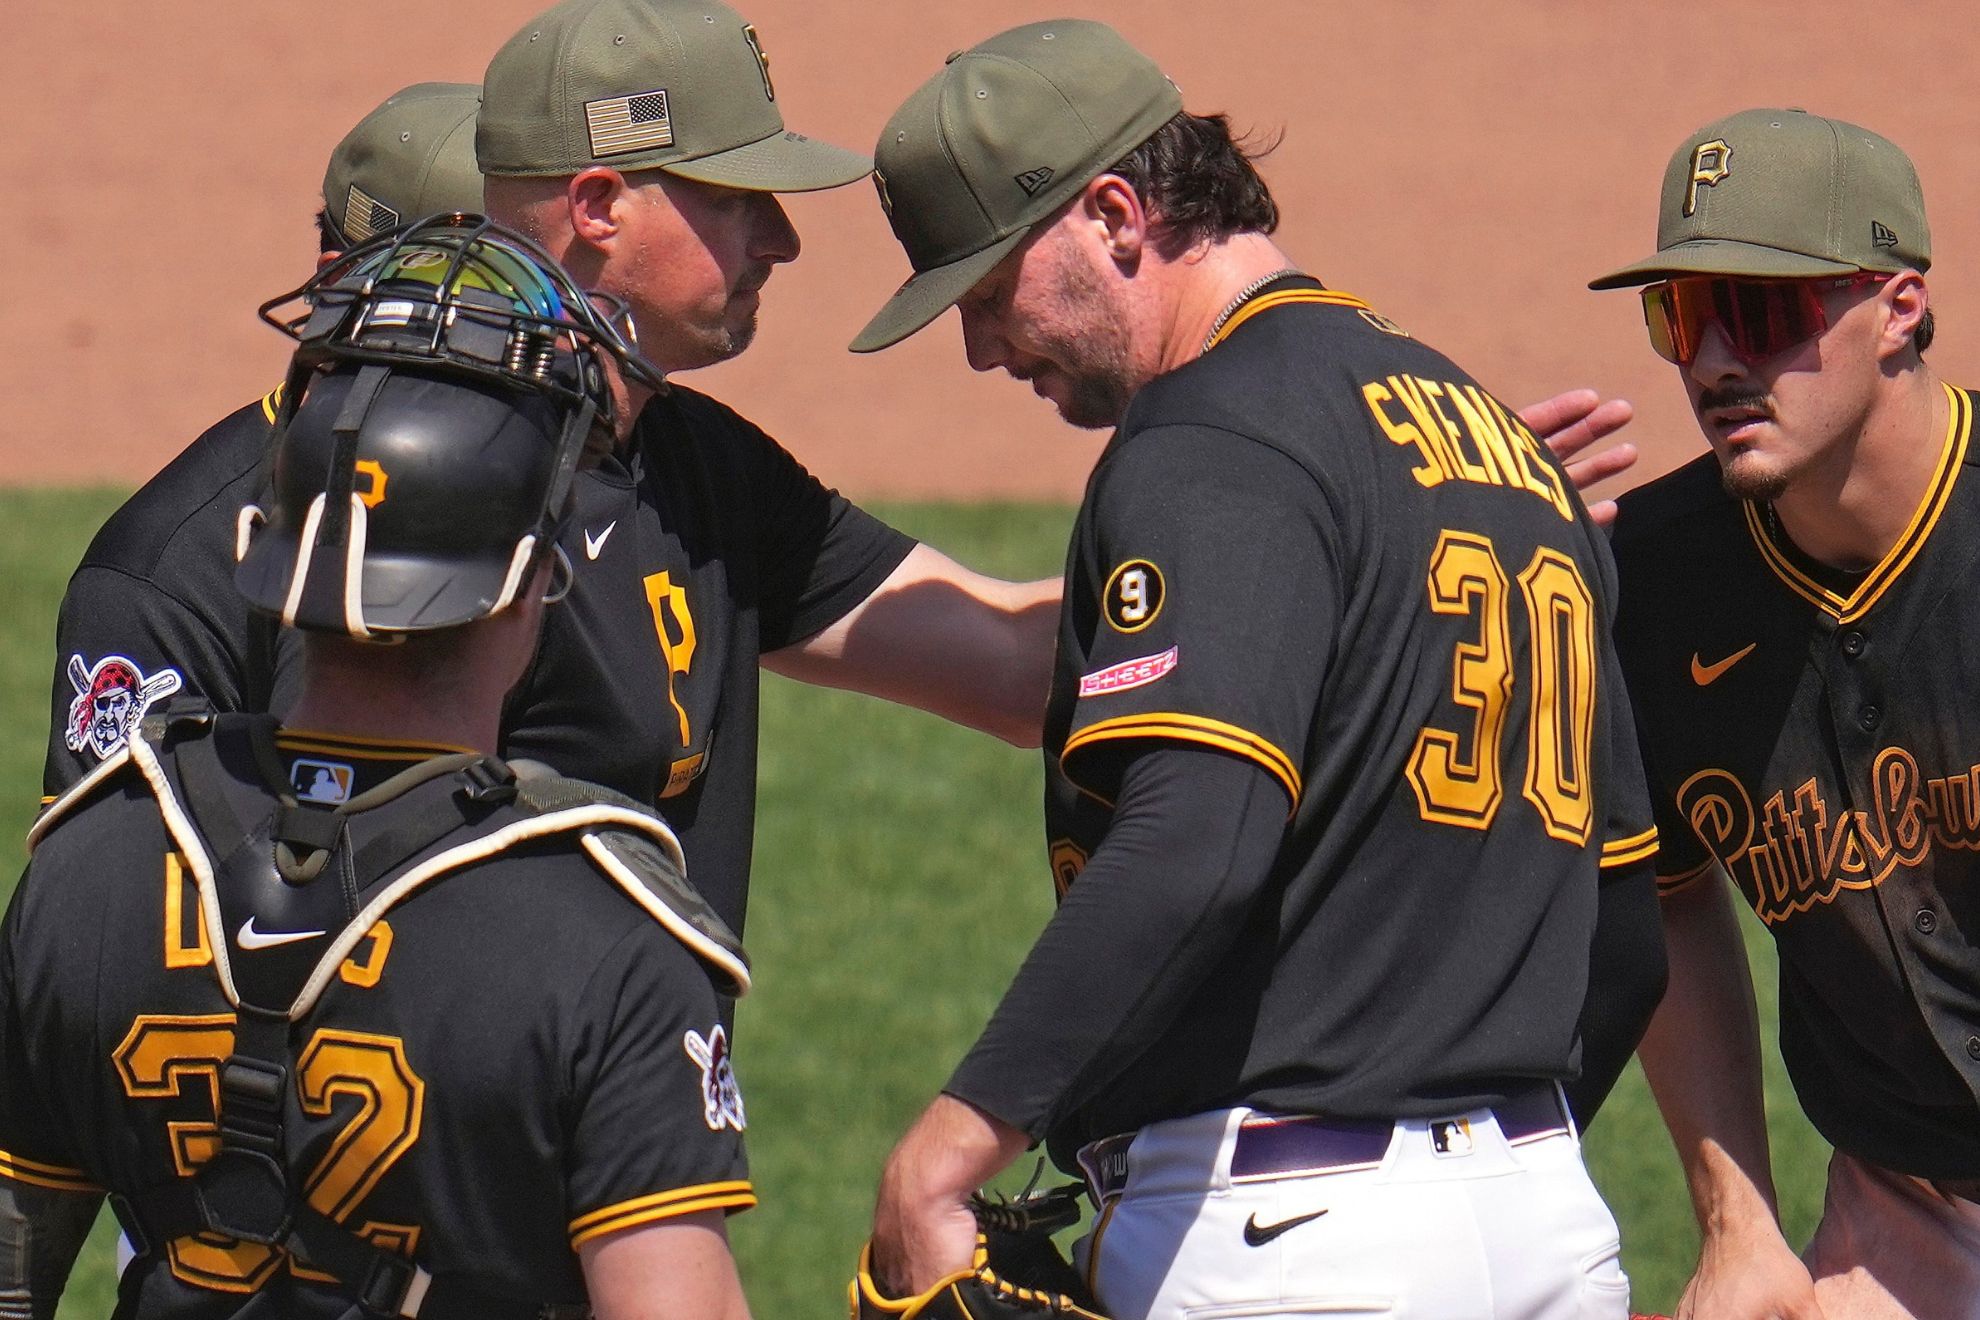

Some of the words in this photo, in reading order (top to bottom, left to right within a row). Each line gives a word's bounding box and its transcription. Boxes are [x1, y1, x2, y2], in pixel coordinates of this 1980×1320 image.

[1682, 138, 1733, 218] P
[1361, 373, 1574, 522] SKENES
[1120, 568, 1149, 622] 9
[1085, 650, 1175, 693] SHEETZ
[1404, 528, 1597, 848] 30
[1676, 746, 1980, 926] Pittsbu
